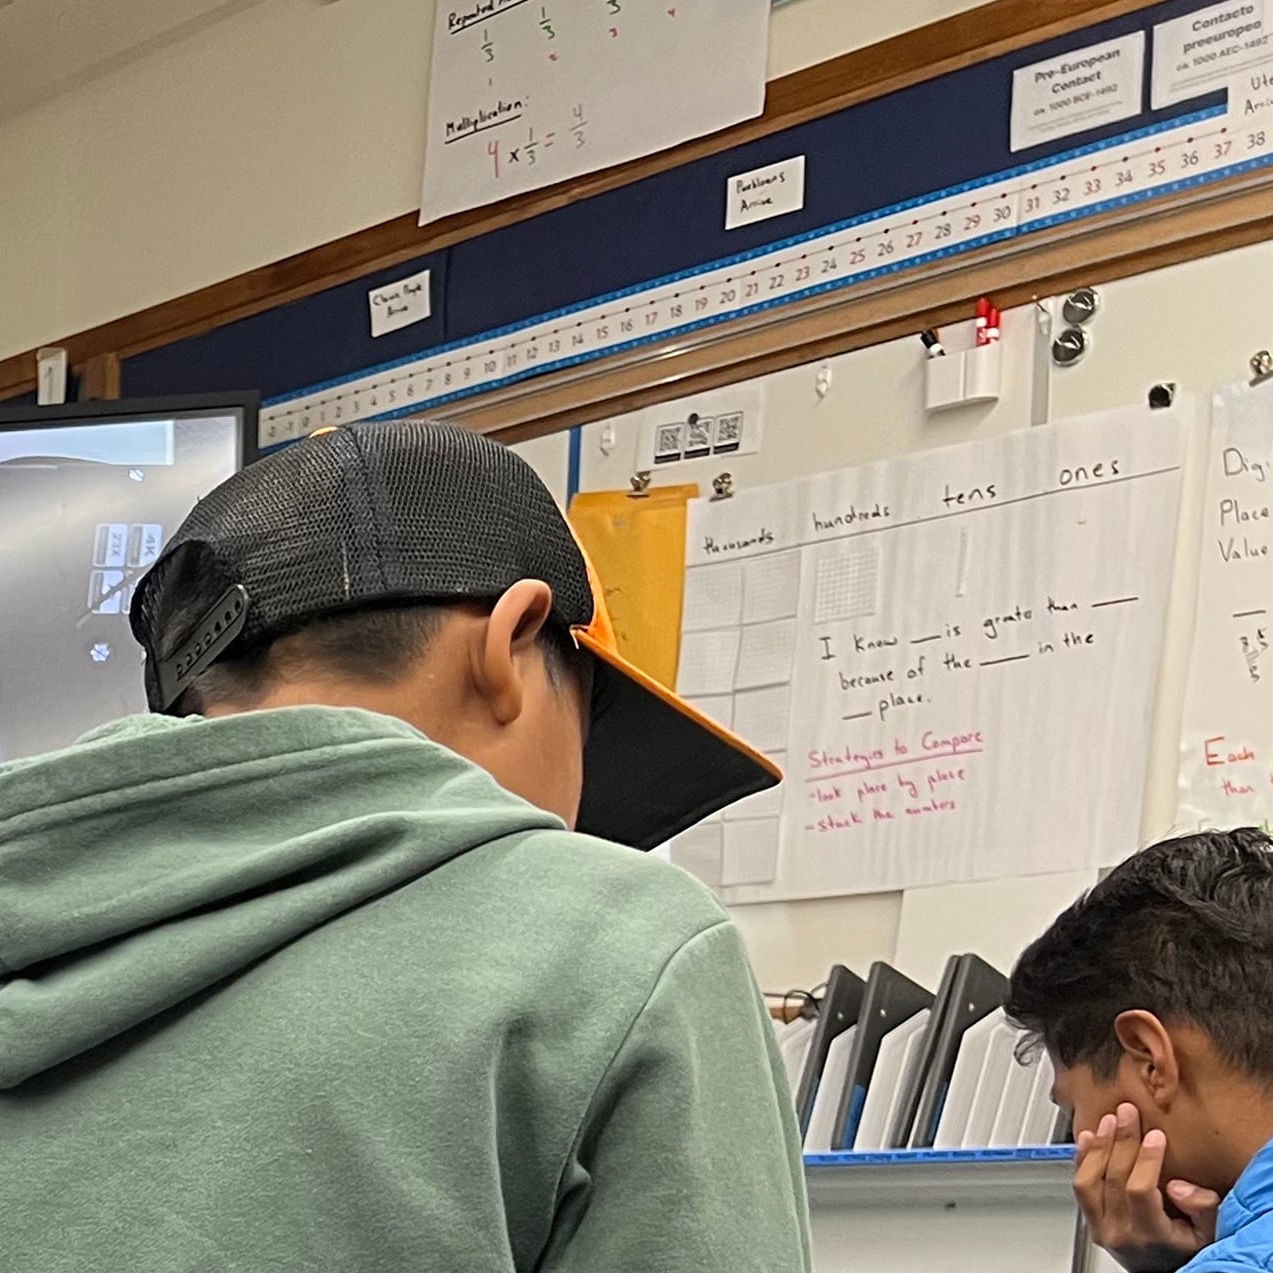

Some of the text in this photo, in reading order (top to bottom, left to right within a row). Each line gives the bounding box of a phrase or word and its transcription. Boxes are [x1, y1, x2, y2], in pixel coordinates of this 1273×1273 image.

[1192, 5, 1254, 32] Contacto
[1183, 20, 1262, 54] preeuropeo
[1034, 49, 1120, 83] Pre-European
[1051, 71, 1102, 93] Contact
[906, 131, 1266, 249] 27 28 29 30 31 32 33 34 35 36 37 38
[703, 460, 1120, 556] thousands hundreds tens ones
[1220, 498, 1269, 526] Place
[1217, 537, 1268, 563] Value
[819, 636, 836, 660] I
[945, 623, 962, 639] is
[839, 632, 1095, 691] because of the in the
[808, 730, 984, 769] Strategies to Compare
[1205, 736, 1254, 766] Each
[857, 768, 966, 801] place by place
[1222, 777, 1254, 797] than
